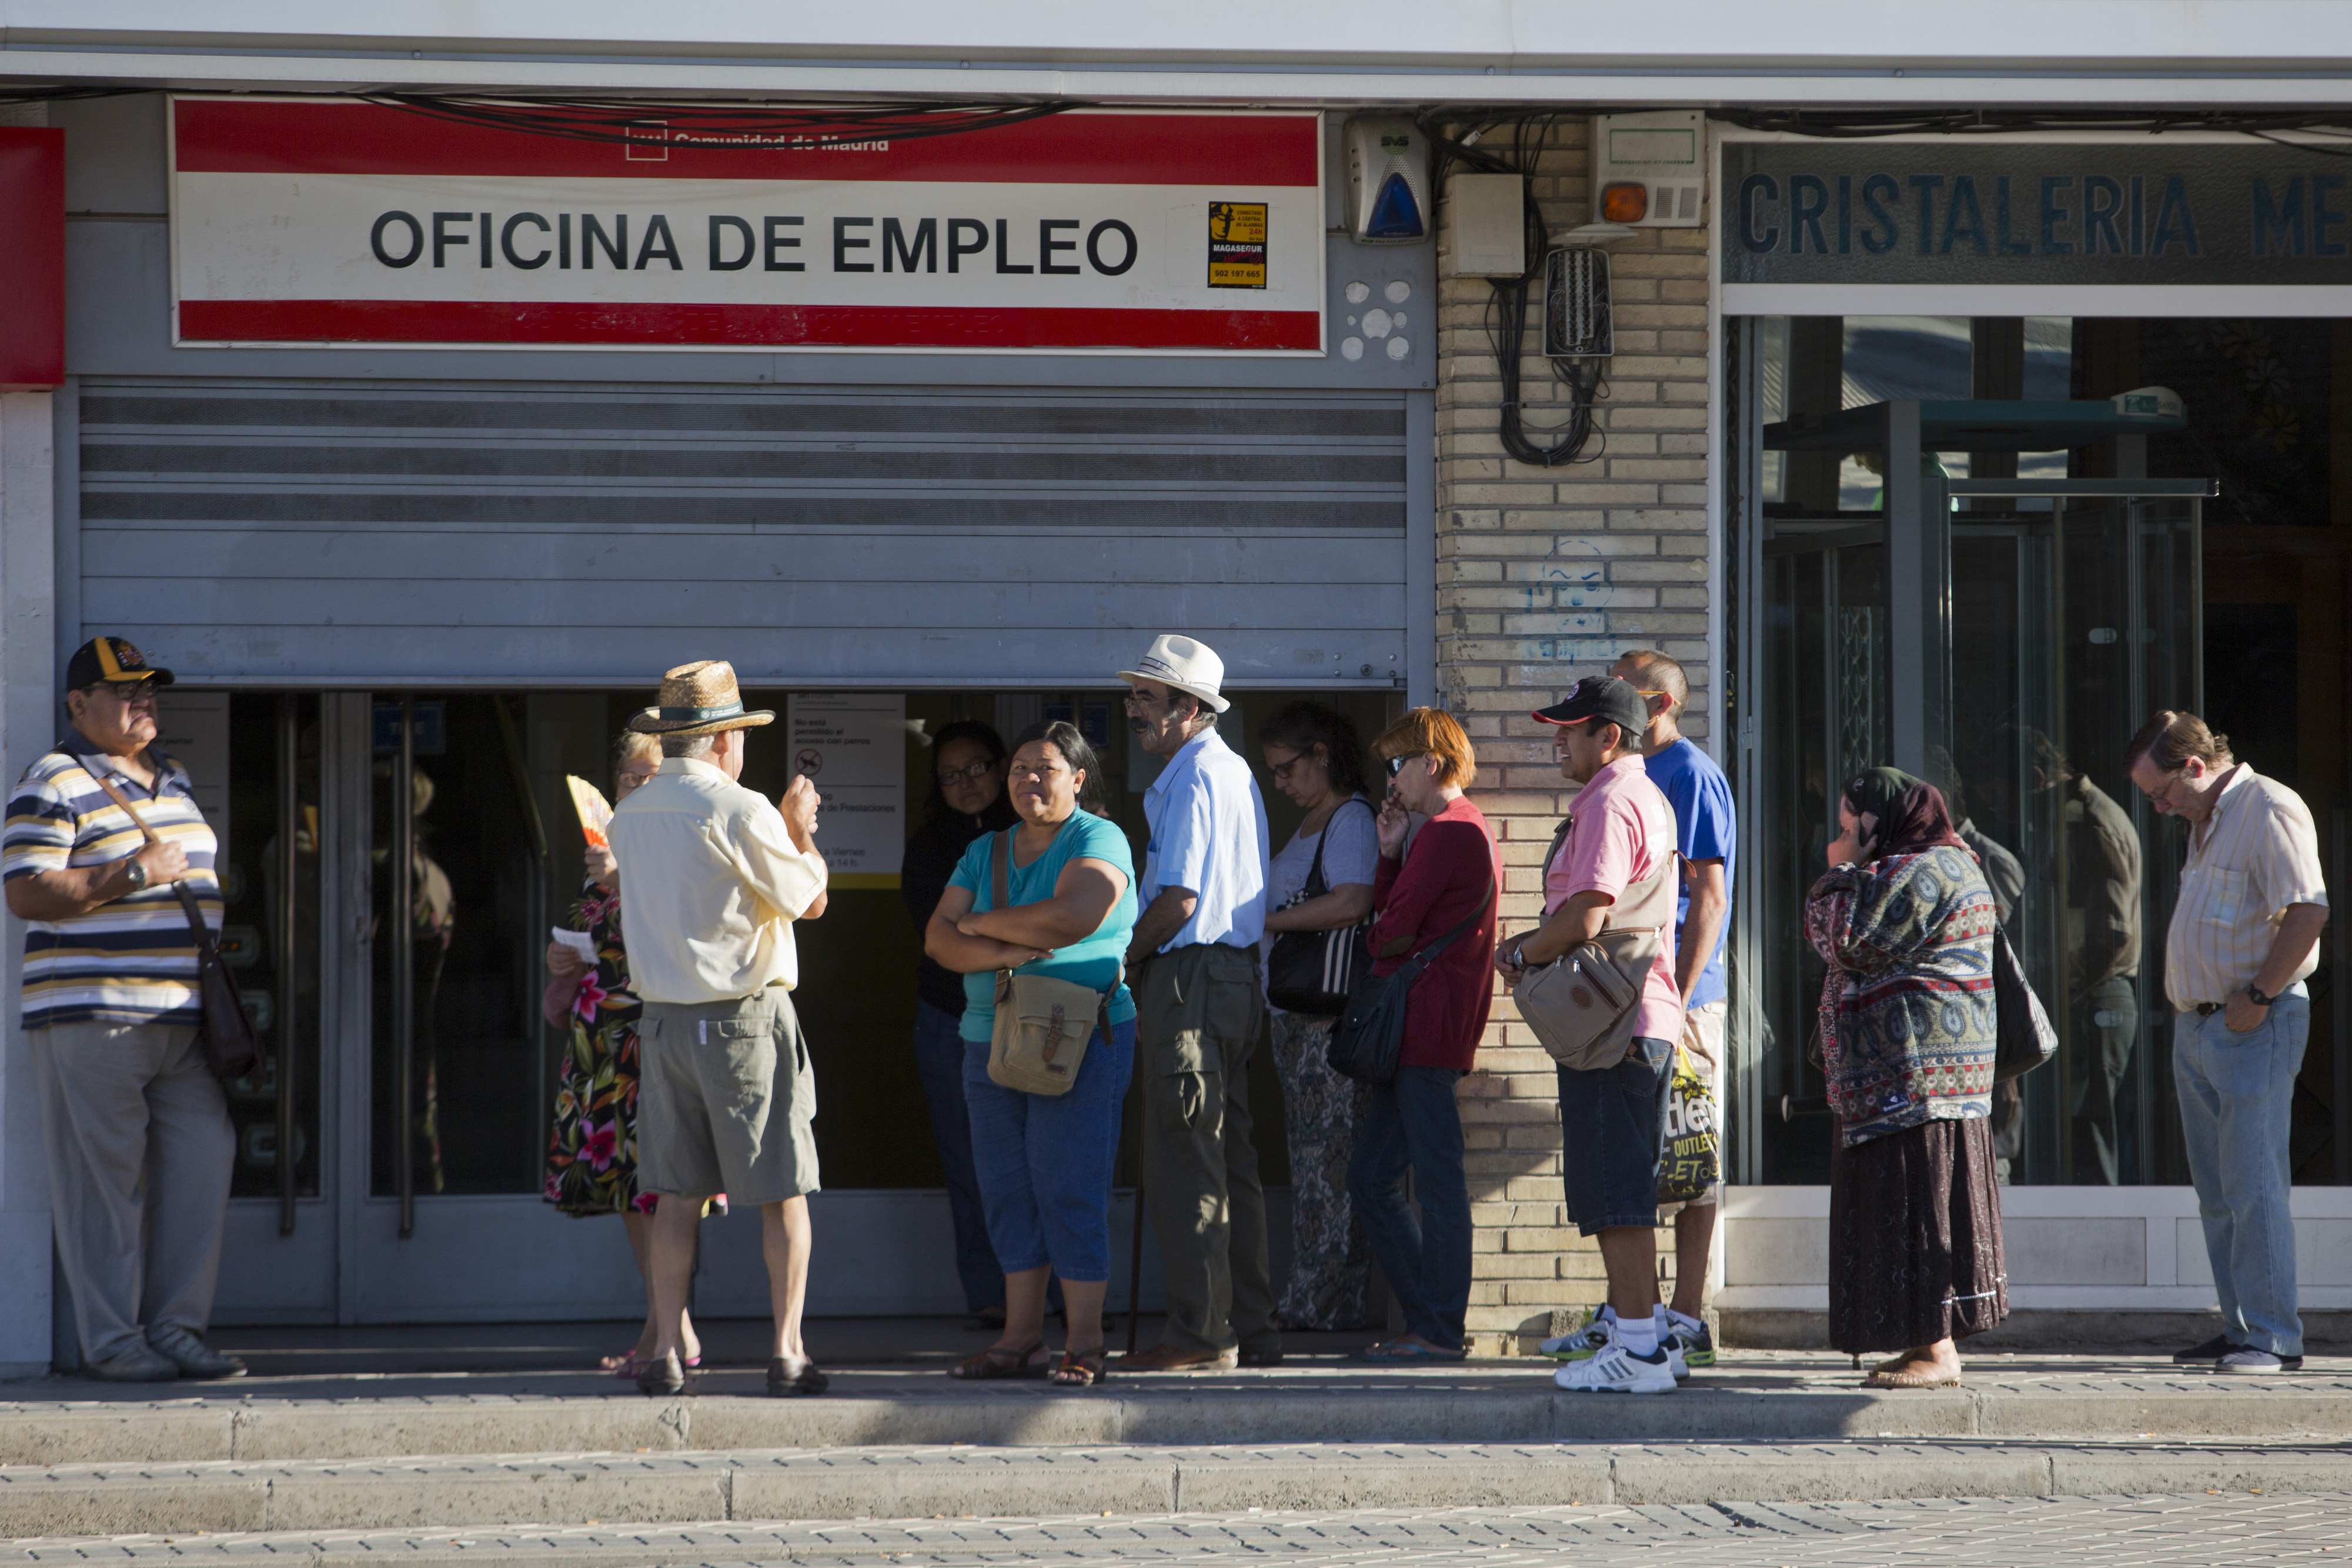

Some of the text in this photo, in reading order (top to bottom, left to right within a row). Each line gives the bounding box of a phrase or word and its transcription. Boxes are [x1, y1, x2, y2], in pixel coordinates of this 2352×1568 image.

[1740, 174, 2198, 255] CRISTALERIA
[370, 210, 1138, 276] OFICINA DE EMPLEO
[1214, 245, 1262, 253] MAGASEGUR
[840, 803, 896, 812] Prestaciones
